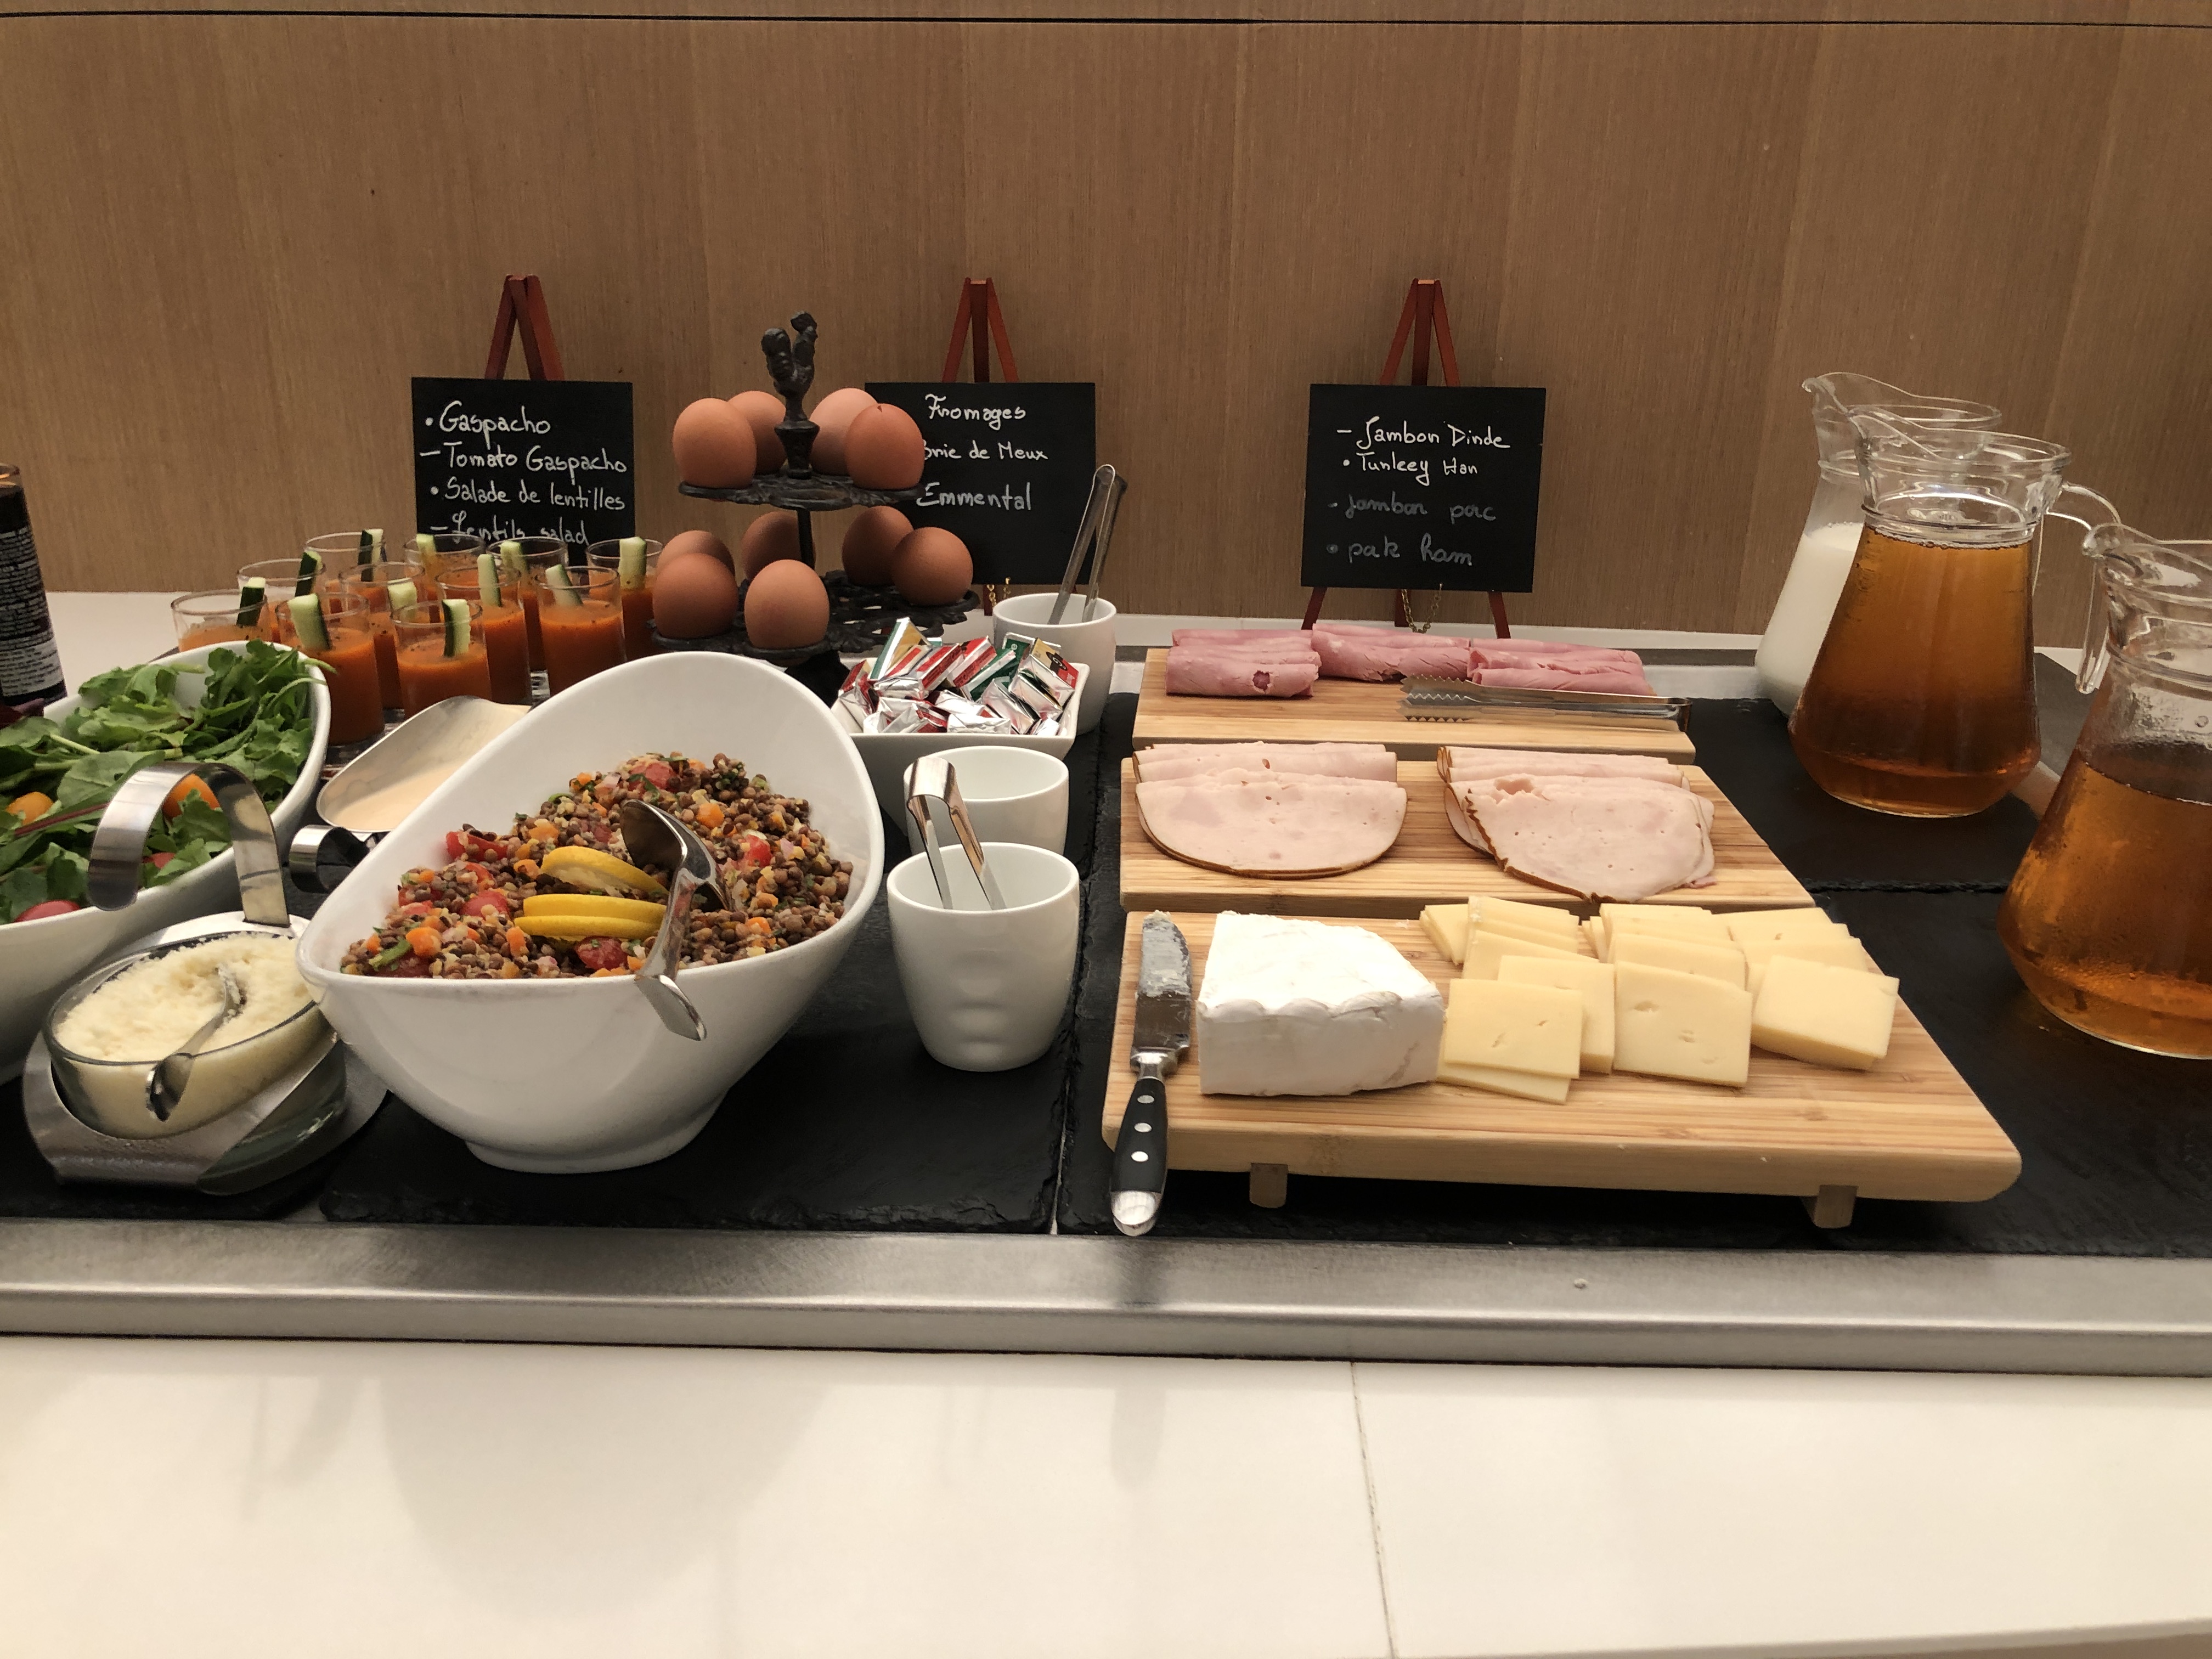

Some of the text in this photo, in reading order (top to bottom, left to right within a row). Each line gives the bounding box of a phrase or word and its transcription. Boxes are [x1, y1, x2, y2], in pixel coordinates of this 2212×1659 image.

[439, 400, 551, 450] Gaspacho
[924, 393, 1026, 431] Fromages
[1356, 415, 1511, 450] Jambon Dinde
[443, 441, 627, 485] Tomato Gaspacho
[969, 439, 990, 459] de
[998, 441, 1048, 461] Meux
[444, 476, 625, 511] Salade de lentilles
[916, 482, 1031, 511] Emmental
[540, 516, 589, 545] salad
[1449, 504, 1496, 524] porc
[1420, 533, 1472, 566] ham
